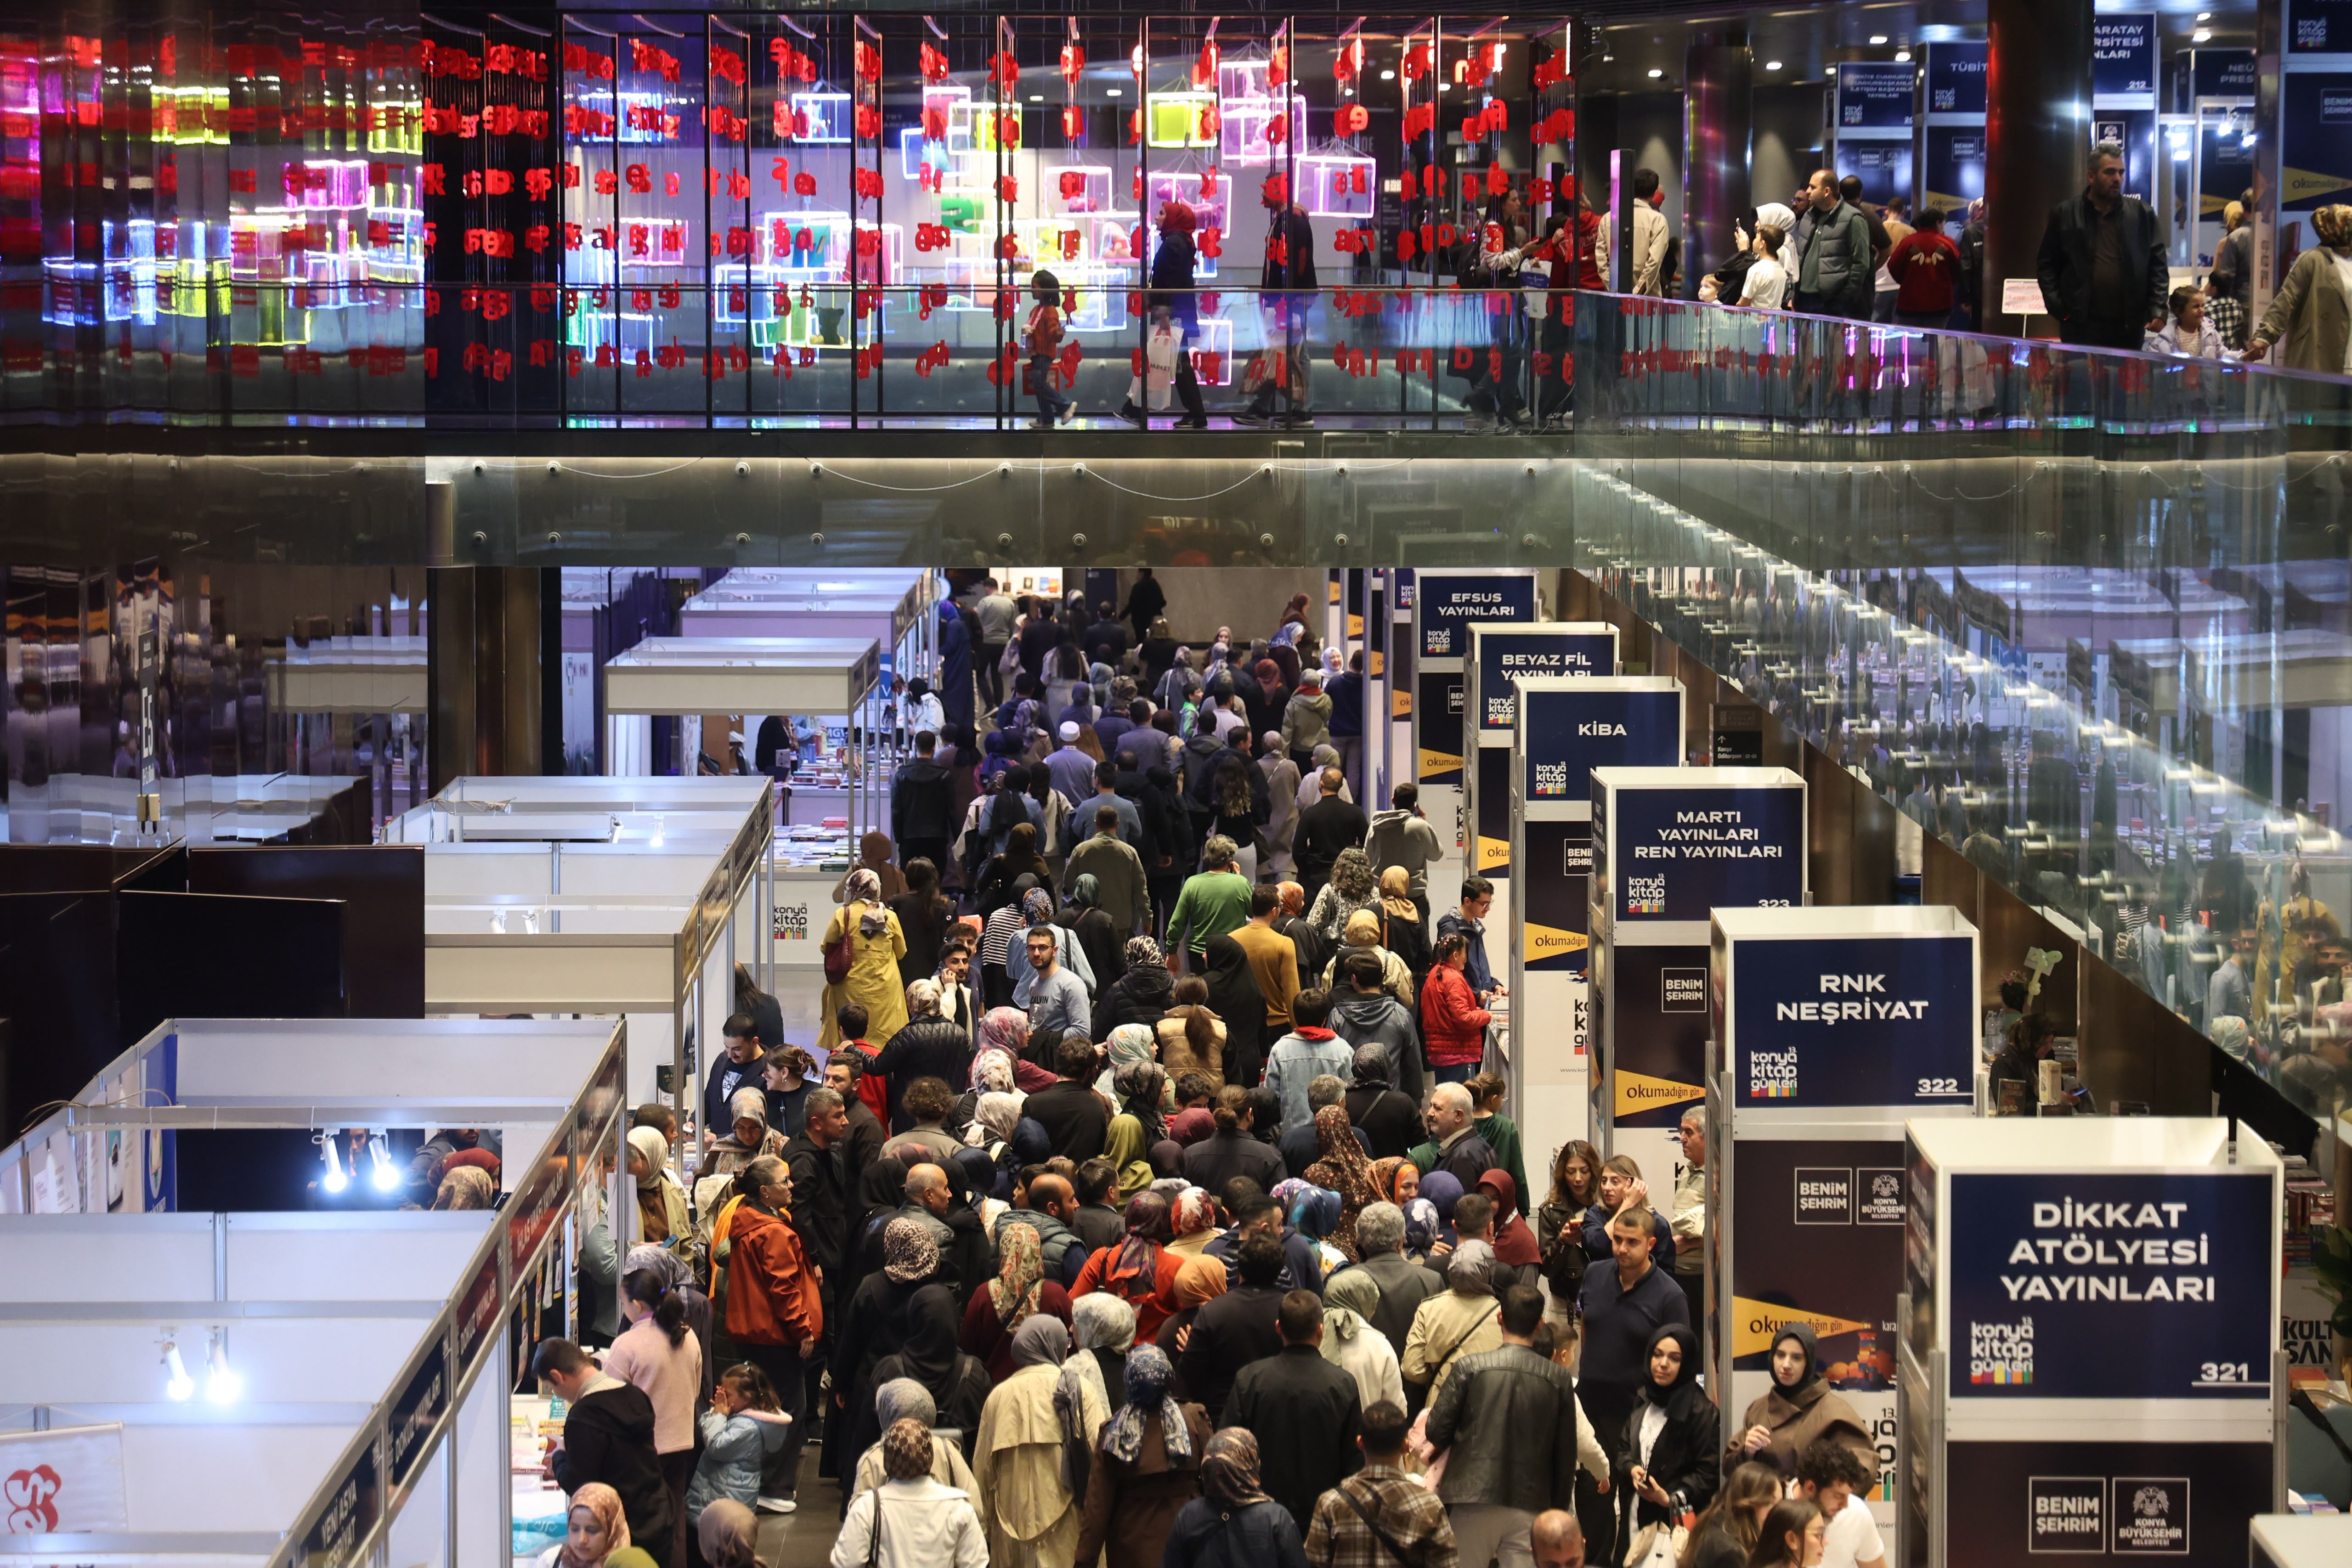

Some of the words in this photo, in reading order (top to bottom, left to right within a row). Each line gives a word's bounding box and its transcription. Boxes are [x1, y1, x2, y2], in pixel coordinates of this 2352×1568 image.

[2094, 26, 2143, 35] ARATAY
[2094, 38, 2143, 46] RSİTESİ
[2094, 50, 2131, 59] NLARI
[1950, 61, 1987, 72] TÜBİT
[1451, 593, 1502, 603] EFSUS
[1438, 606, 1515, 616] YAYINLARI
[1427, 635, 1450, 645] kitap
[1502, 654, 1560, 665] BEYAZ
[1565, 652, 1592, 665] FİL
[1578, 720, 1628, 736] KİBA
[1536, 764, 1566, 774] konya
[1536, 772, 1566, 783] kitap
[1536, 781, 1566, 790] günleri
[1677, 811, 1741, 823] MARTI
[1658, 829, 1758, 840] YAYINLARI
[1635, 846, 1676, 858] REN
[1681, 846, 1782, 858] YAYINLARI
[1567, 858, 1592, 867] ŞEHRİ
[1628, 876, 1664, 888] konya
[1628, 886, 1664, 899] kitap
[1628, 897, 1664, 908] günleri
[774, 905, 807, 916] konya
[774, 914, 807, 927] kitap
[774, 925, 807, 935] günleri
[1666, 979, 1703, 990] BENİM
[1821, 975, 1886, 993] RNK
[1030, 996, 1049, 1004] CALVIN
[1666, 991, 1703, 1002] ŞEHRİM
[1777, 997, 1929, 1025] NEŞRİYAT
[1751, 1050, 1797, 1066] konya
[1751, 1063, 1797, 1080] kitap
[1627, 1084, 1688, 1098] okumadığın
[1690, 1088, 1699, 1097] gün
[1751, 1078, 1797, 1091] günleri
[1917, 1079, 1958, 1094] 322
[1800, 1182, 1847, 1196] BENİM
[1800, 1197, 1847, 1211] ŞEHRİM
[2033, 1196, 2188, 1228] DİKKAT
[2008, 1233, 2209, 1265] ATÖLYESİ
[2001, 1276, 2215, 1302] YAYINLARI
[1750, 1315, 1827, 1334] okudığın
[1830, 1320, 1843, 1332] gün
[1971, 1320, 2034, 1343] konya
[1971, 1337, 2034, 1360] kitap
[2284, 1341, 2332, 1364] SAN
[1970, 1358, 2034, 1376] günleri
[2201, 1363, 2249, 1382] 321
[395, 1418, 415, 1465] DOKUZ
[415, 1371, 441, 1431] YAYINLARI
[2035, 1496, 2100, 1515] BENİM
[322, 1497, 338, 1549] YENİ
[339, 1478, 357, 1525] ASYA
[2035, 1516, 2100, 1536] ŞEHRİM
[2135, 1518, 2166, 1527] KONYA
[2119, 1526, 2182, 1540] BÜYÜKŞEHİR
